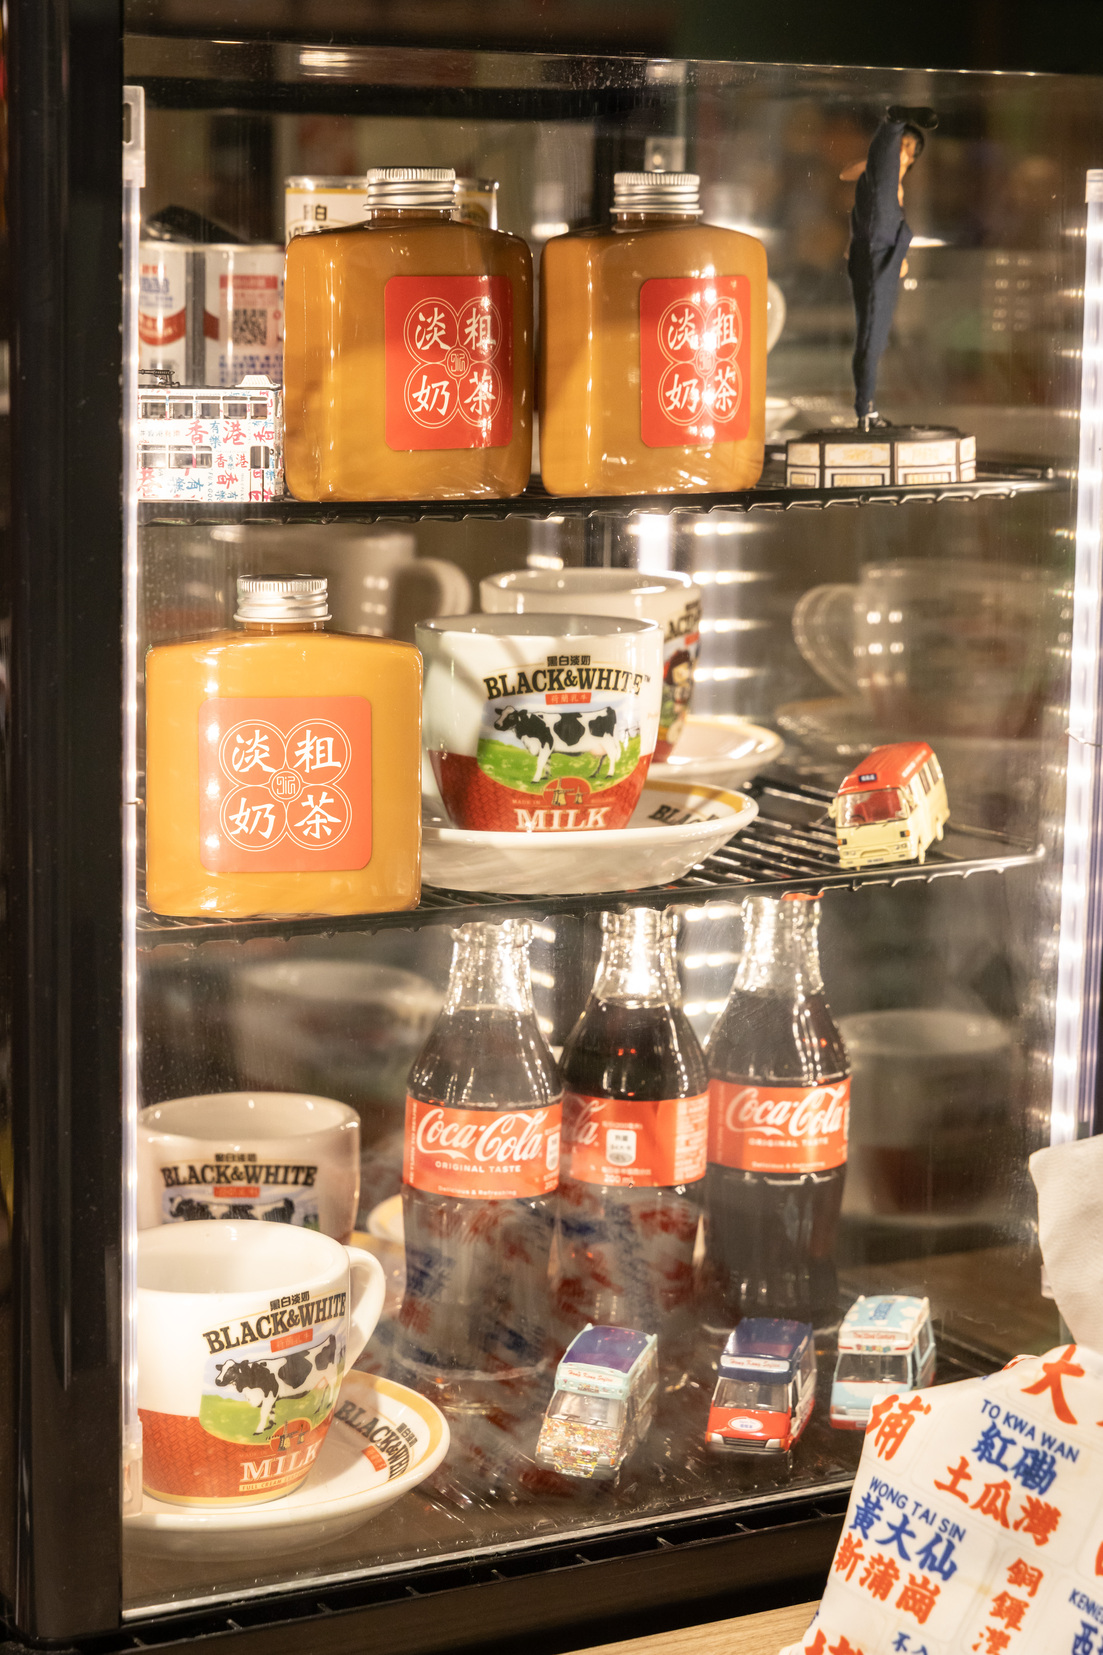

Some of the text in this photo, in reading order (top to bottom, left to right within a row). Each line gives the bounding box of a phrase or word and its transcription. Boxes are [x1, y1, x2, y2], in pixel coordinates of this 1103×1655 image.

[513, 806, 611, 830] MILK
[160, 1164, 319, 1187] BLACK&WHITE
[435, 1160, 522, 1173] ORIGINAL TASTE
[202, 1292, 347, 1354] BLACK&WHITE
[981, 1399, 1080, 1463] TO KWA WAN
[240, 1437, 323, 1483] MILK
[869, 1476, 967, 1543] WONG TAI SIN
[933, 1456, 1062, 1546] 土瓜灣
